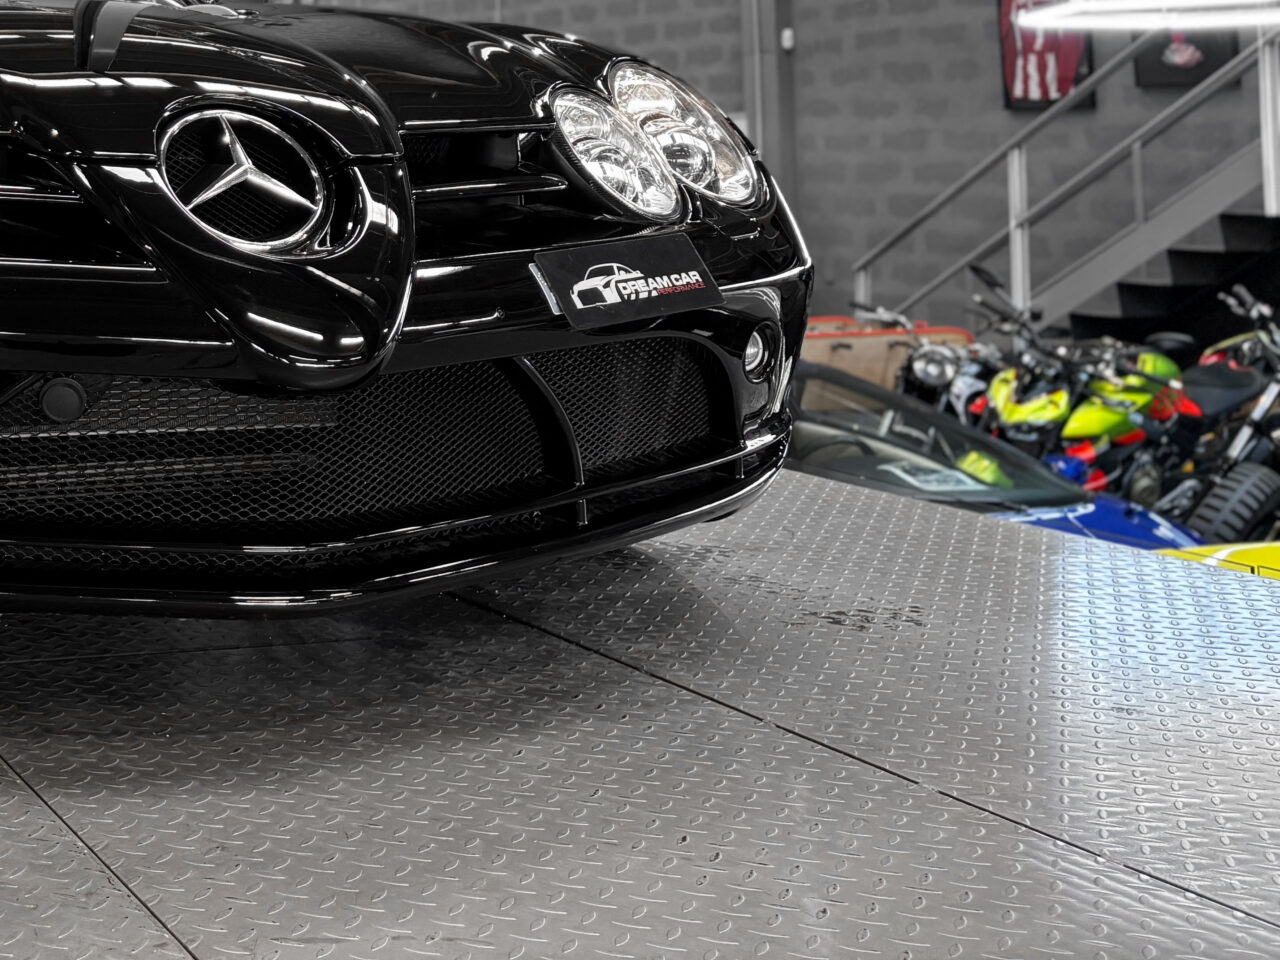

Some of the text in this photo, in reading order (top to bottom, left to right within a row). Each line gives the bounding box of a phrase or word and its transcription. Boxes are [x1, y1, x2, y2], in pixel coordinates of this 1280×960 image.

[617, 270, 702, 295] DREAM CAR
[656, 281, 706, 295] PERFORMANCE
